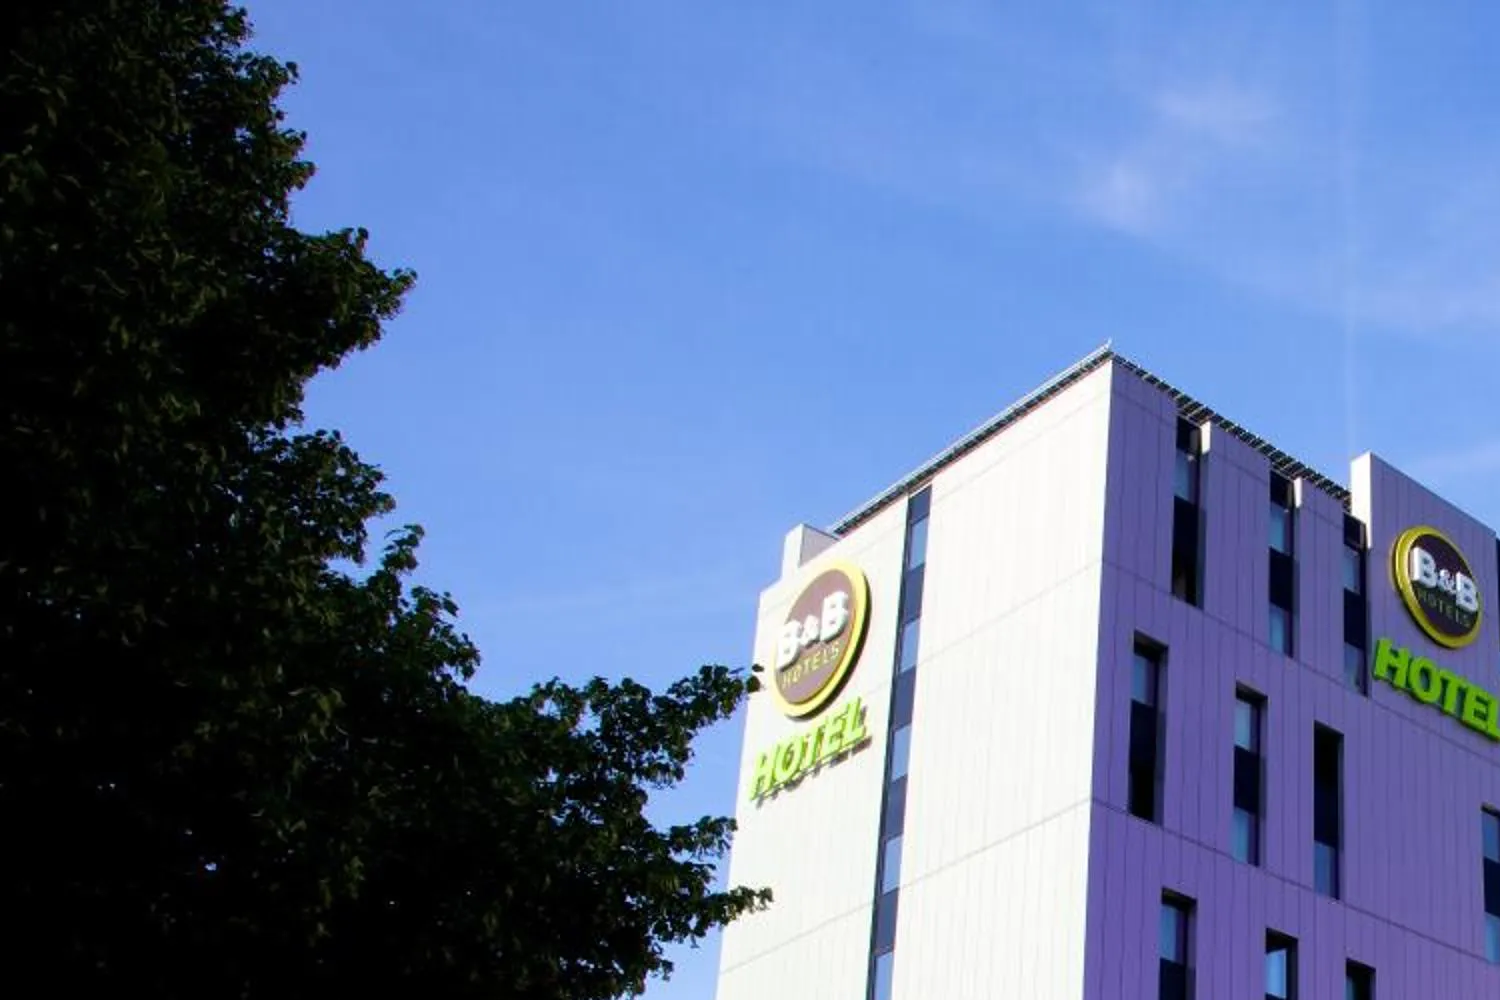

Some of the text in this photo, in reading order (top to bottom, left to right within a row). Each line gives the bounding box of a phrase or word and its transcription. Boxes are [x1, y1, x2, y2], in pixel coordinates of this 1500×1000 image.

[1411, 547, 1478, 612] B&B
[777, 590, 849, 672] B&B
[782, 647, 839, 690] HOTELS
[751, 697, 867, 800] HOTEL
